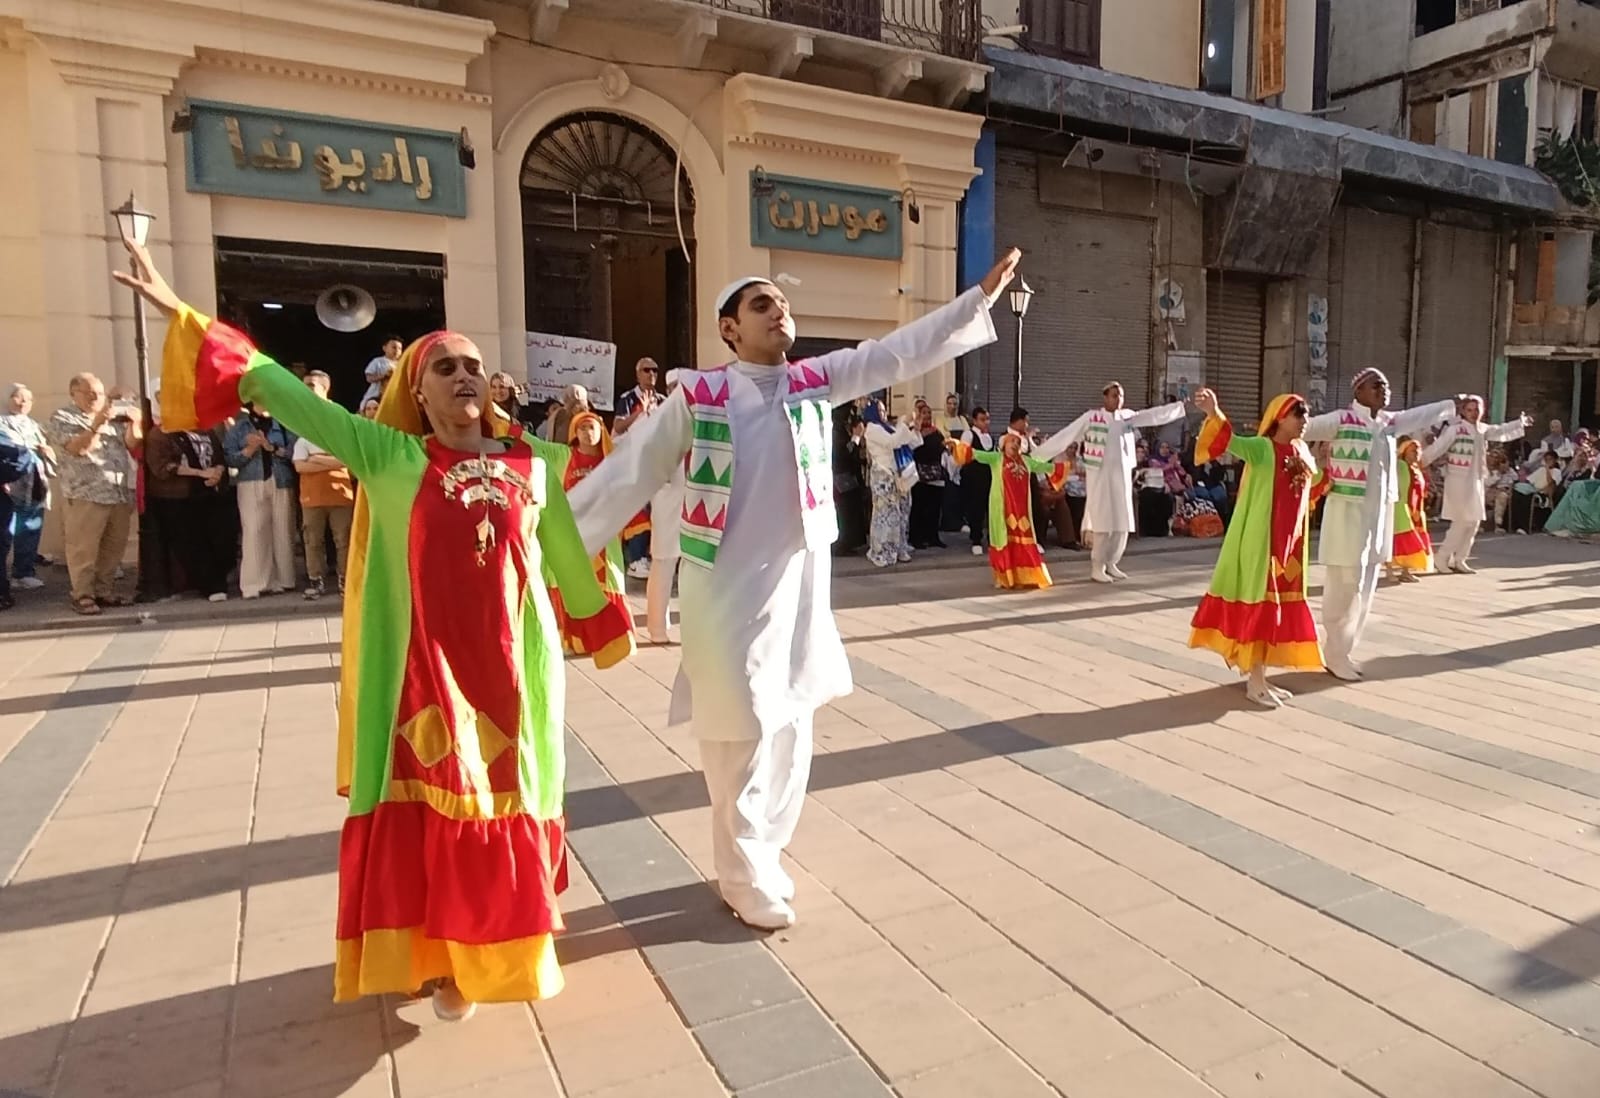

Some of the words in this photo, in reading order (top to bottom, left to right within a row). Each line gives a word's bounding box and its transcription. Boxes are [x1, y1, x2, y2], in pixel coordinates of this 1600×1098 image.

[313, 136, 432, 200] راديو
[769, 191, 888, 240] مودرن
[538, 360, 553, 369] محمد
[556, 364, 579, 375] حسن
[581, 364, 596, 374] محمد
